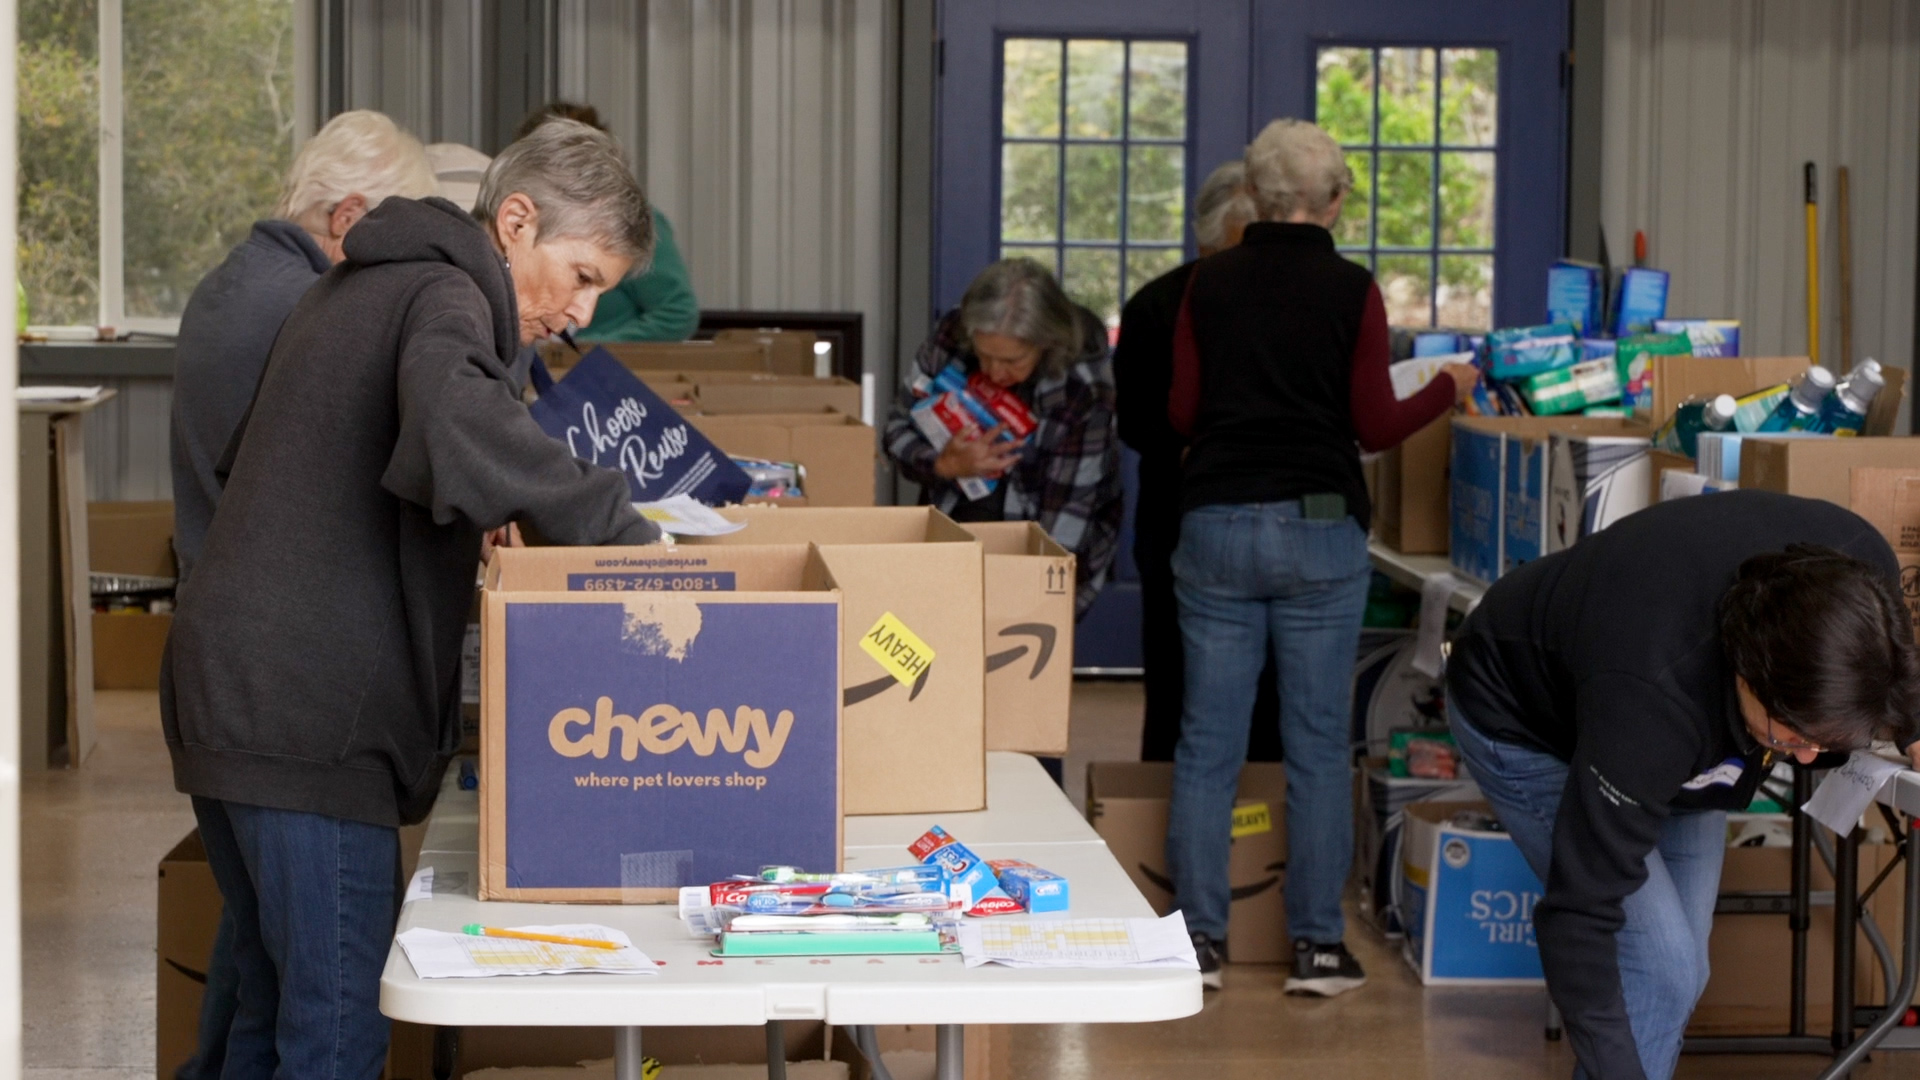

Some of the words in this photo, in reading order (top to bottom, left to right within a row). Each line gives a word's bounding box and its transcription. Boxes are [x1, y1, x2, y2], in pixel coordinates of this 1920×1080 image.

[566, 397, 648, 465] Choose
[620, 424, 688, 489] Reuse
[584, 577, 719, 591] 1-800-672-4399
[595, 557, 707, 569] service@chewy.com
[868, 624, 926, 676] HEAVY
[548, 696, 794, 769] chewy
[574, 771, 629, 787] where
[633, 773, 663, 791] pet
[667, 771, 721, 787] lovers
[725, 771, 767, 791] shop
